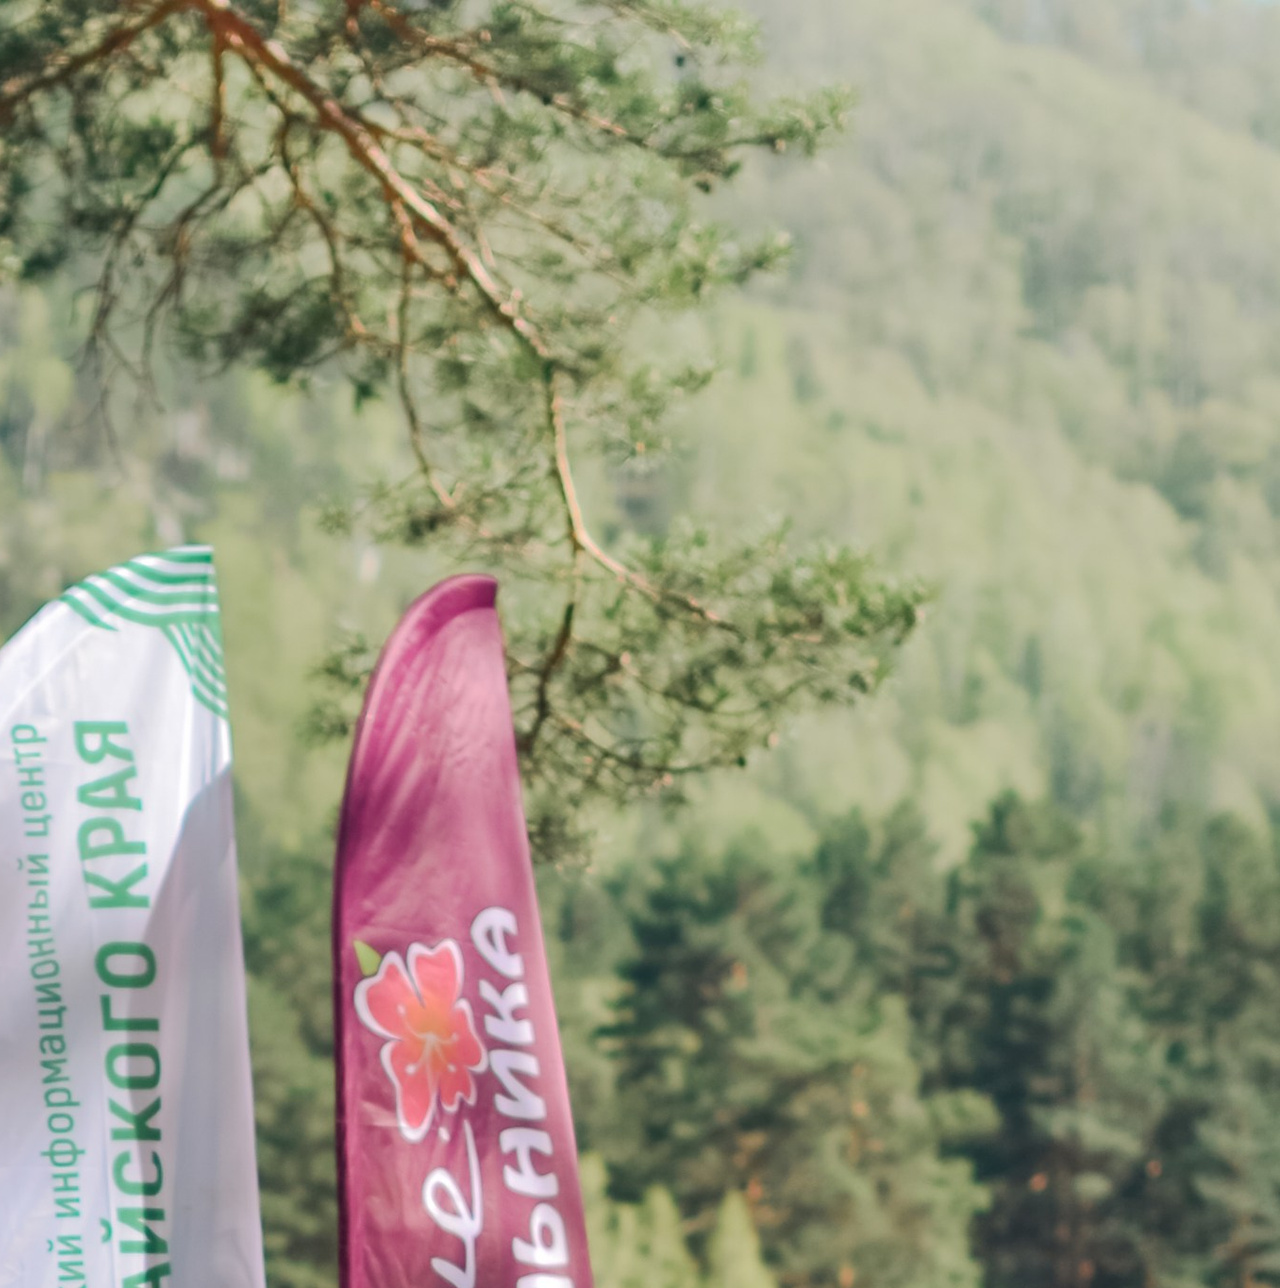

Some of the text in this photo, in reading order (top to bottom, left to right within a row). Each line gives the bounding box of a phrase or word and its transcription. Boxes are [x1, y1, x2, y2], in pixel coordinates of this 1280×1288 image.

[10, 722, 53, 838] центр
[73, 720, 151, 909] КРАЯ
[17, 852, 86, 1219] информационный
